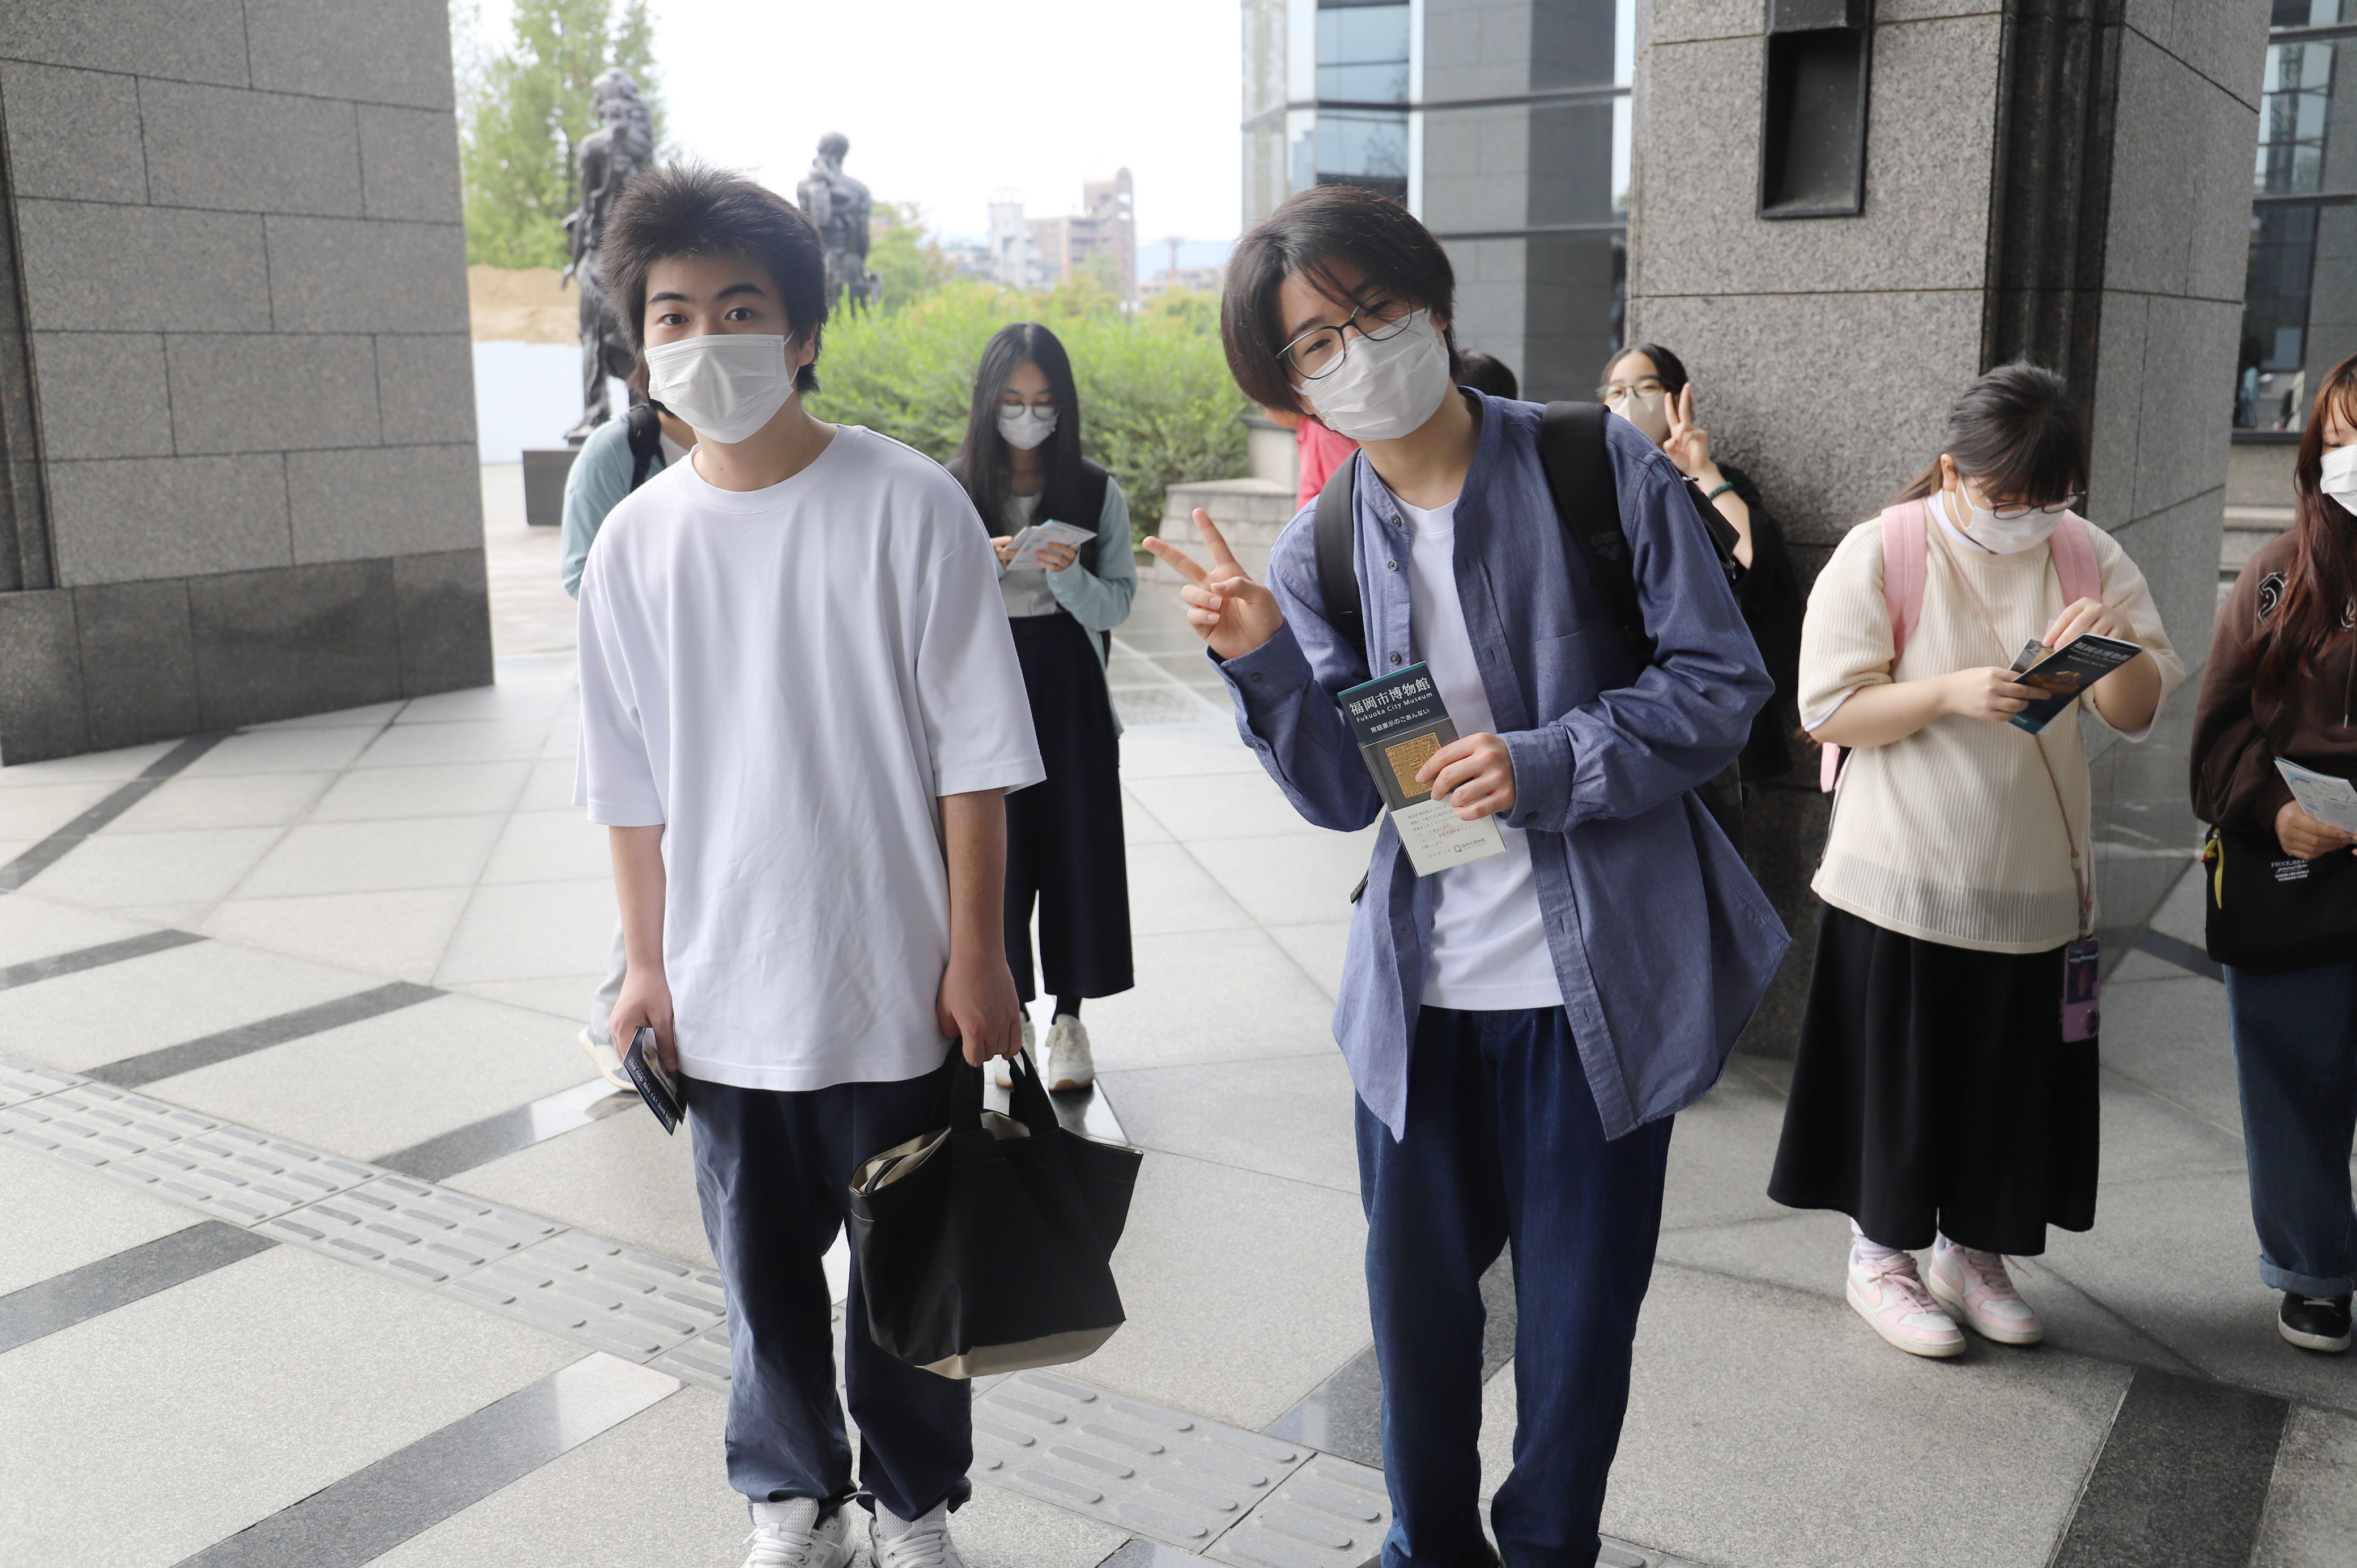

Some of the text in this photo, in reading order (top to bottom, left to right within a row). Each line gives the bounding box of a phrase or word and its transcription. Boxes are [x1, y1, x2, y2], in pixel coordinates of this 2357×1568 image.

[1348, 677, 1431, 716] 福岡市博物館
[1356, 692, 1433, 722] Fukuoka City Museum
[1370, 708, 1430, 734] 常設展示のごあんない
[1461, 837, 1485, 847] 福岡市博物館
